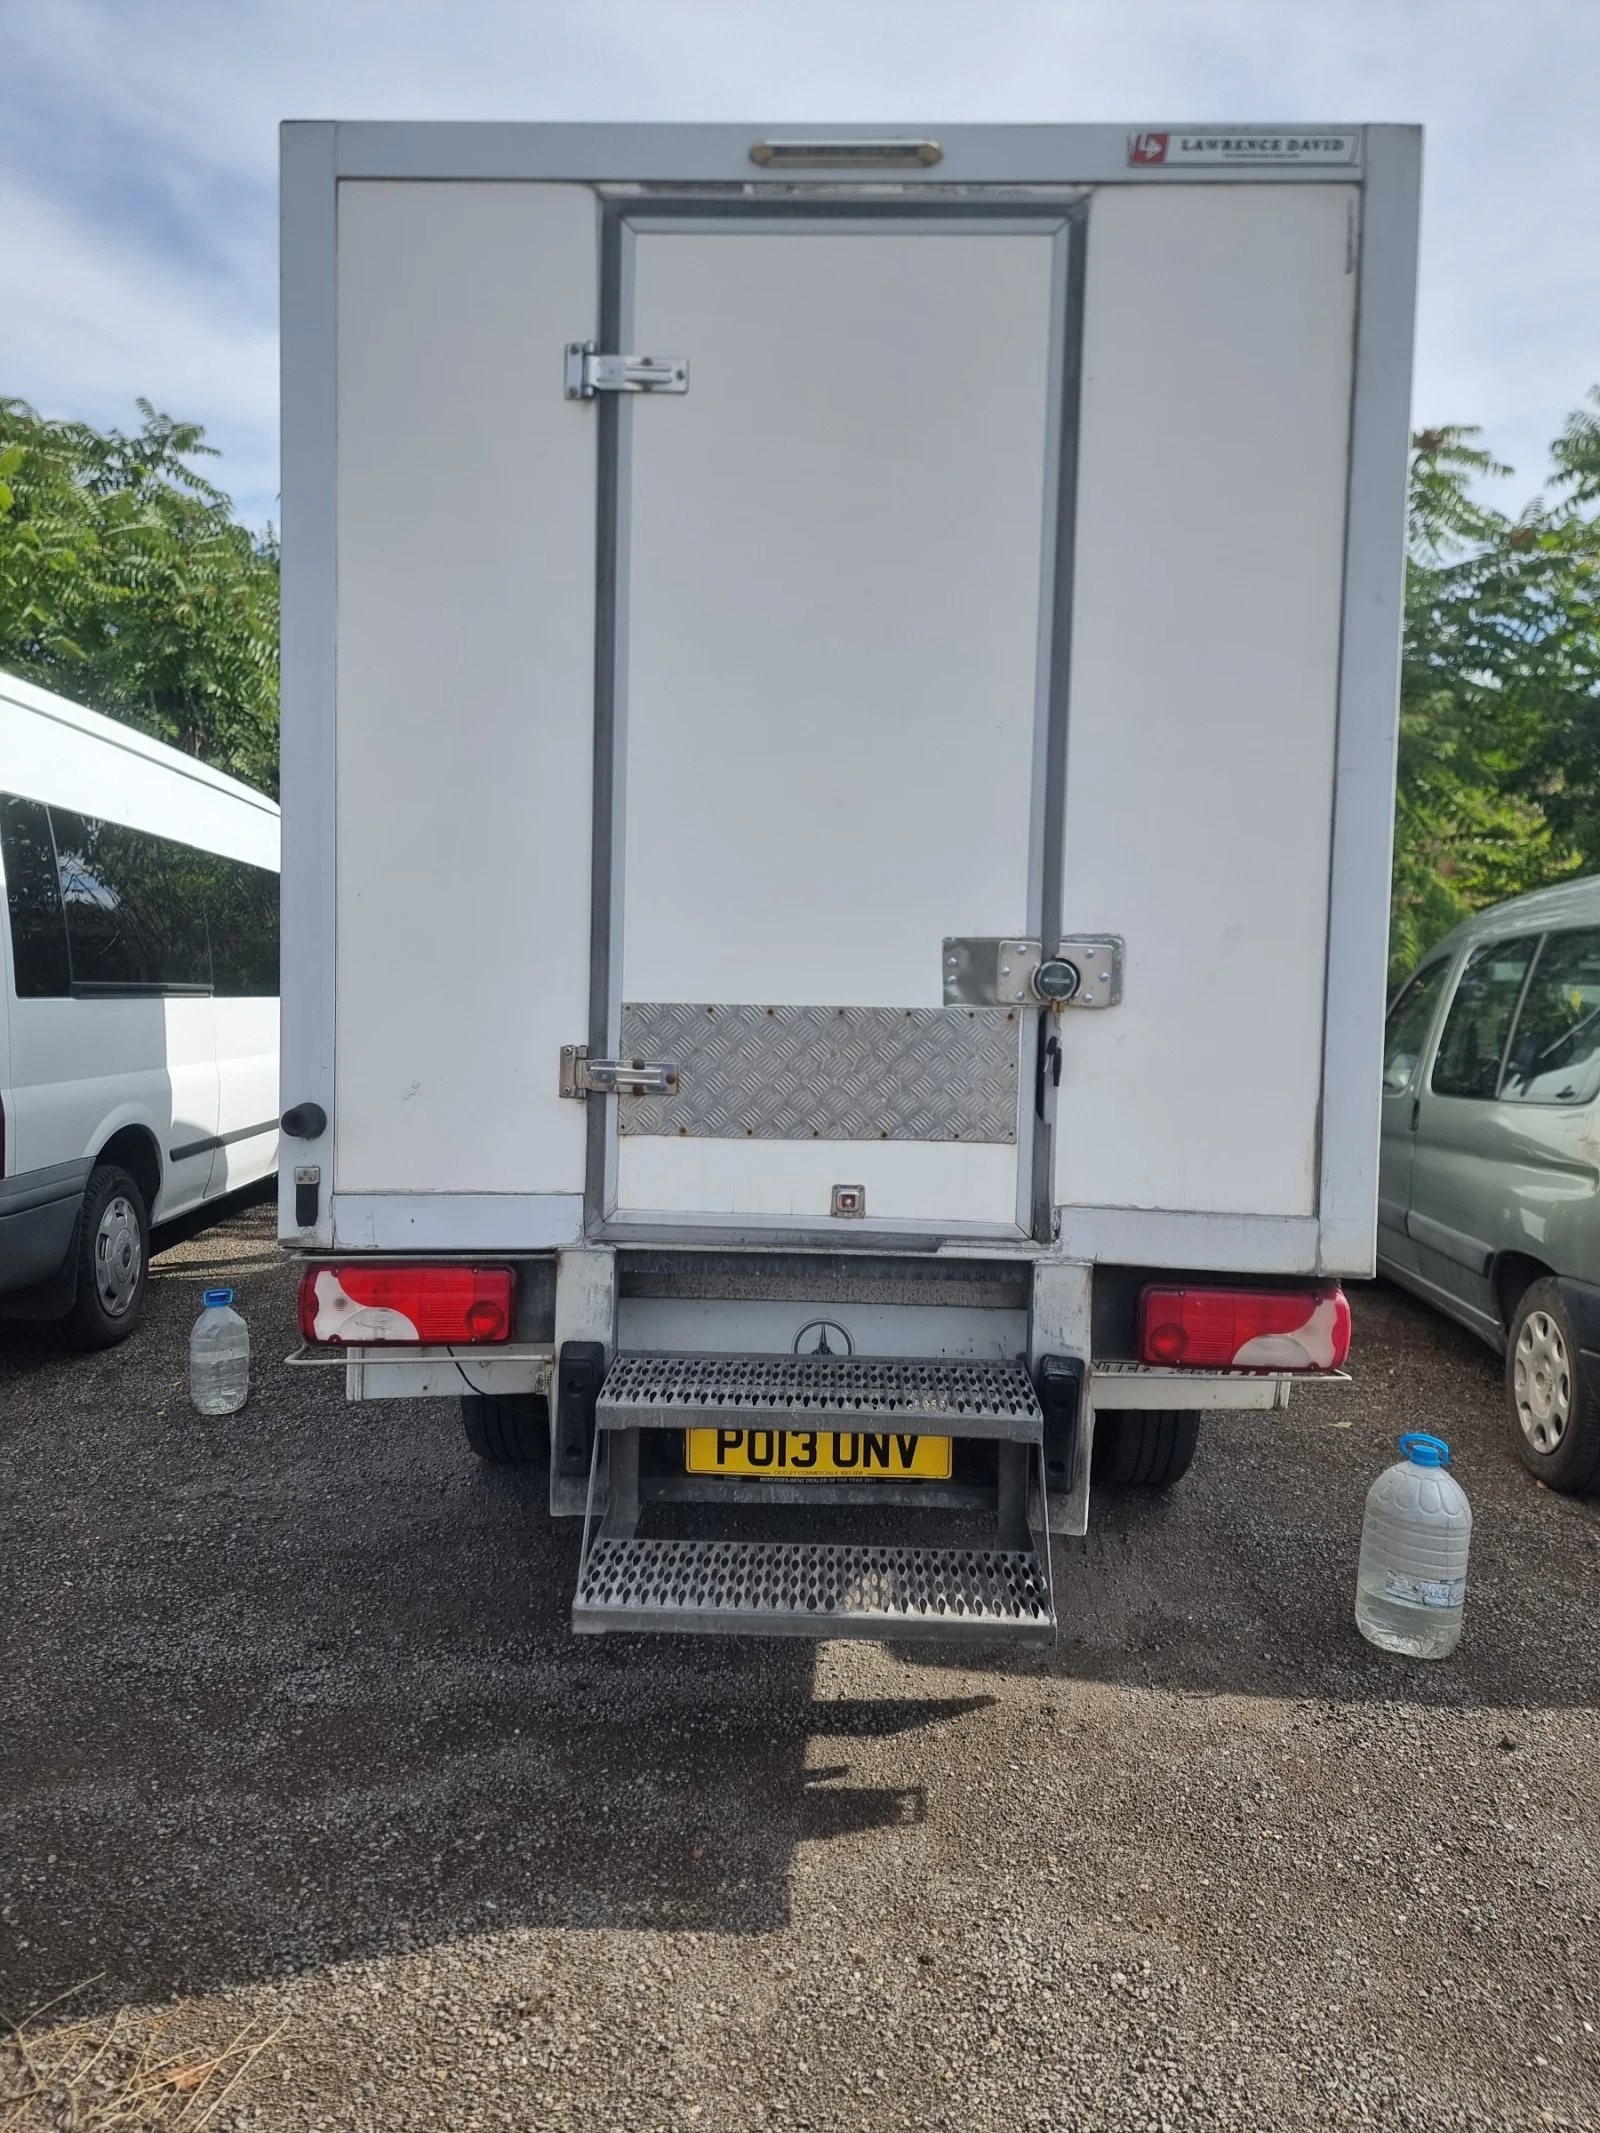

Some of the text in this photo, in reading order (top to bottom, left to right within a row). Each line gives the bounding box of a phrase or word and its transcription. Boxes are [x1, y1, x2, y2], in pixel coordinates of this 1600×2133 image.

[1181, 139, 1344, 152] LAWRENCE DAVID
[716, 1429, 920, 1469] PO13 UNV
